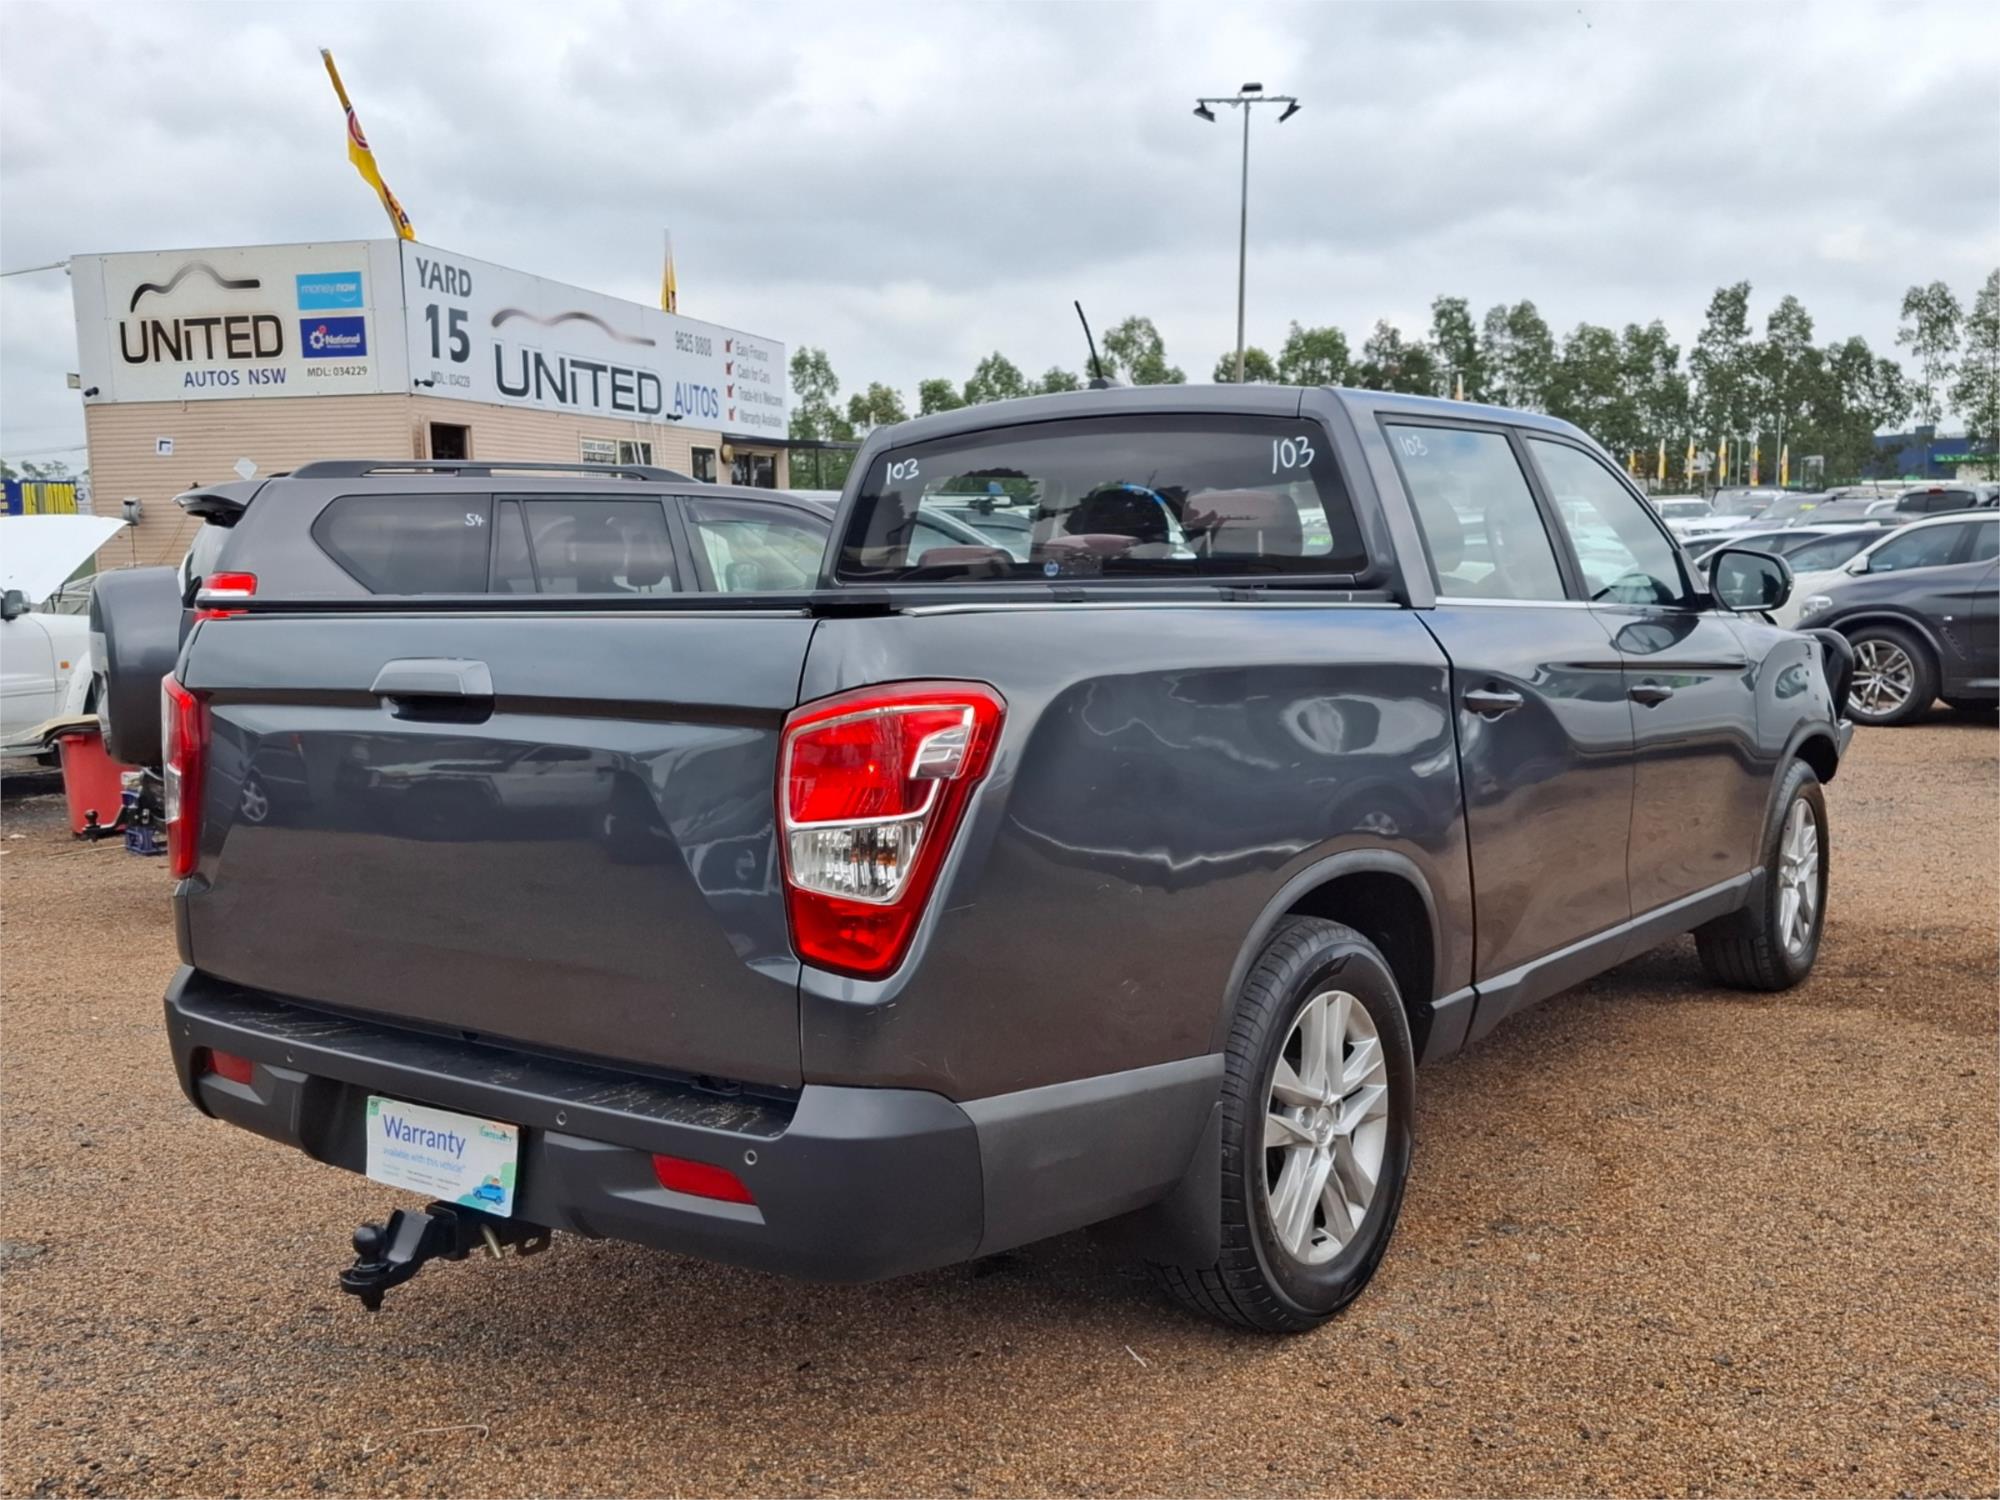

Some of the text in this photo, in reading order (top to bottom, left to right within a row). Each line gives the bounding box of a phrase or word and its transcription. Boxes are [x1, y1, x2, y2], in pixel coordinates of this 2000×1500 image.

[415, 257, 473, 298] YARD
[325, 333, 361, 346] National
[425, 303, 471, 364] 15
[183, 367, 287, 388] AUTOS NSW
[307, 366, 368, 377] MDL: 034229
[674, 382, 719, 419] AUTOS
[1271, 436, 1316, 475] 103
[1399, 434, 1429, 457] 103
[885, 458, 920, 486] 103
[382, 1114, 466, 1160] Warranty
